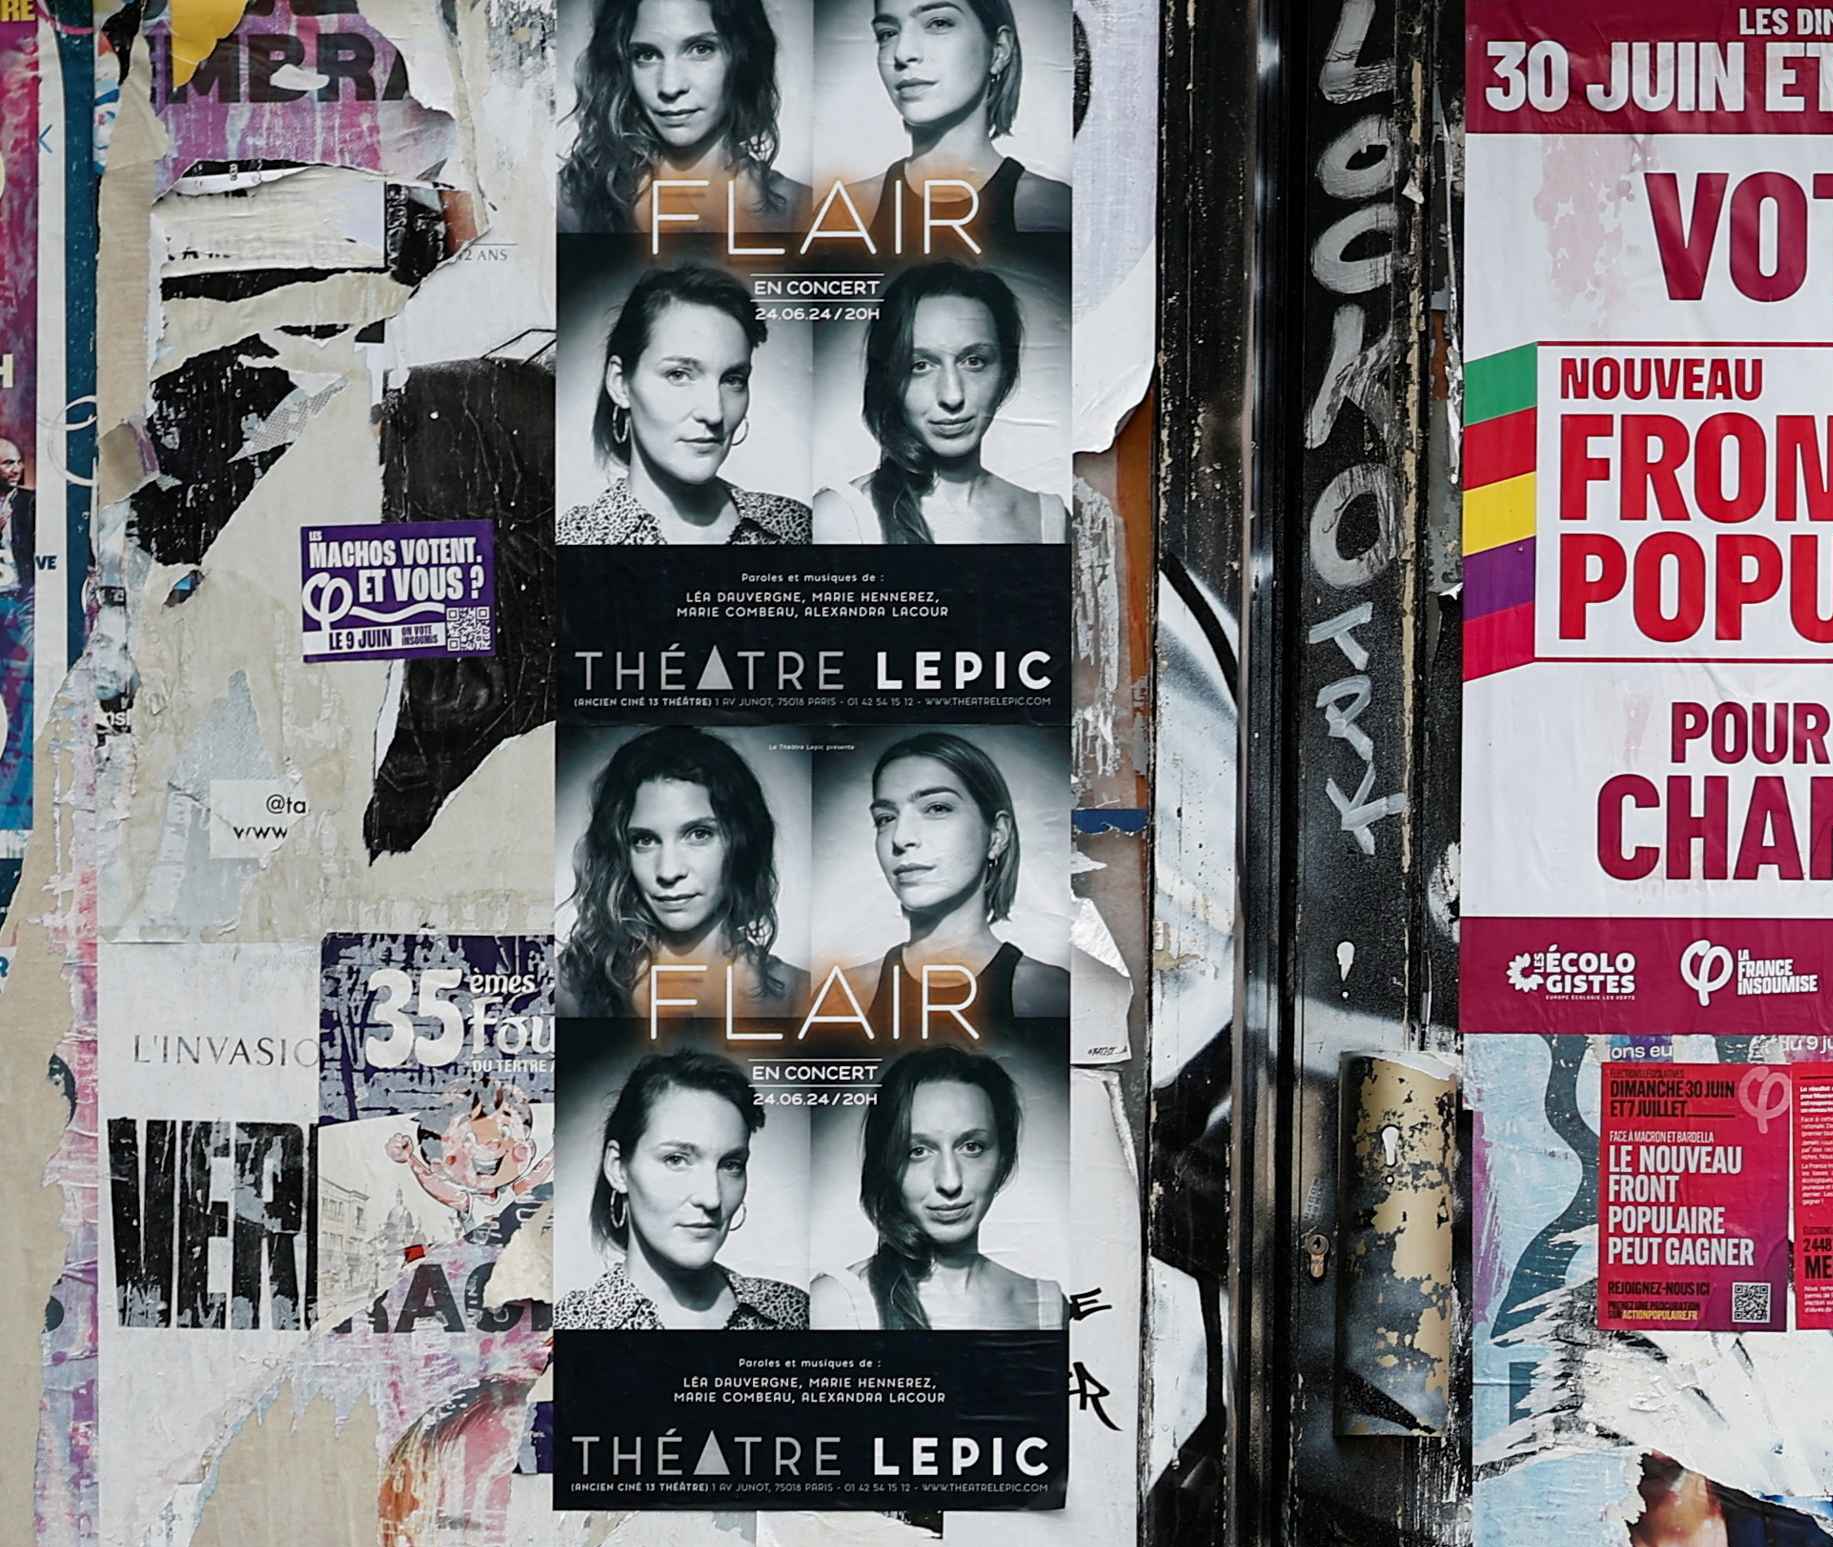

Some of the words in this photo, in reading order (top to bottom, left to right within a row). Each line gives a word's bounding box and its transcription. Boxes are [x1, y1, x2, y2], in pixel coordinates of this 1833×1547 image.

[1740, 8, 1788, 35] LES
[1486, 40, 1558, 112] 30
[1587, 41, 1744, 112] JUIN
[653, 180, 981, 254] FLAIR
[755, 281, 781, 295] EN
[787, 281, 880, 294] CONCERT
[1561, 357, 1762, 400] NOUVEAU
[310, 540, 396, 568] MACHOS
[400, 537, 482, 565] VOTENT.
[359, 569, 386, 602] ET
[392, 566, 463, 601] VOUS
[470, 565, 484, 598] ?
[742, 573, 783, 582] Paroles
[804, 574, 857, 583] musiques
[687, 591, 710, 602] LÉA
[718, 592, 805, 603] DAUVERGNE,
[812, 592, 854, 602] MARIE
[861, 592, 939, 603] HENNEREZ,
[677, 607, 719, 617] MARIE
[726, 607, 798, 618] COMBEAU,
[805, 607, 885, 617] ALEXANDRA
[893, 607, 948, 617] LACOUR
[330, 631, 342, 650] LE
[346, 630, 354, 649] 9
[358, 629, 392, 648] JUIN
[878, 651, 1051, 689] LEPIC
[1671, 702, 1830, 764] POUR
[1547, 945, 1635, 973] ÉCOLO
[1738, 958, 1793, 979] FRANCE
[1546, 975, 1634, 993] GISTES
[1738, 974, 1817, 995] INSOUMISE
[651, 965, 979, 1040] FLAIR
[366, 968, 463, 1070] 35
[753, 1066, 779, 1080] EN
[785, 1066, 878, 1080] CONCERT
[1610, 1080, 1684, 1098] DIMANCHE
[1609, 1146, 1632, 1173] LE
[1639, 1146, 1742, 1174] NOUVEAU
[1609, 1175, 1679, 1202] FRONT
[1609, 1206, 1726, 1234] POPULAIRE
[1608, 1237, 1662, 1265] PEUT
[1665, 1238, 1754, 1266] GAGNER
[875, 1437, 1048, 1476] LEPIC
